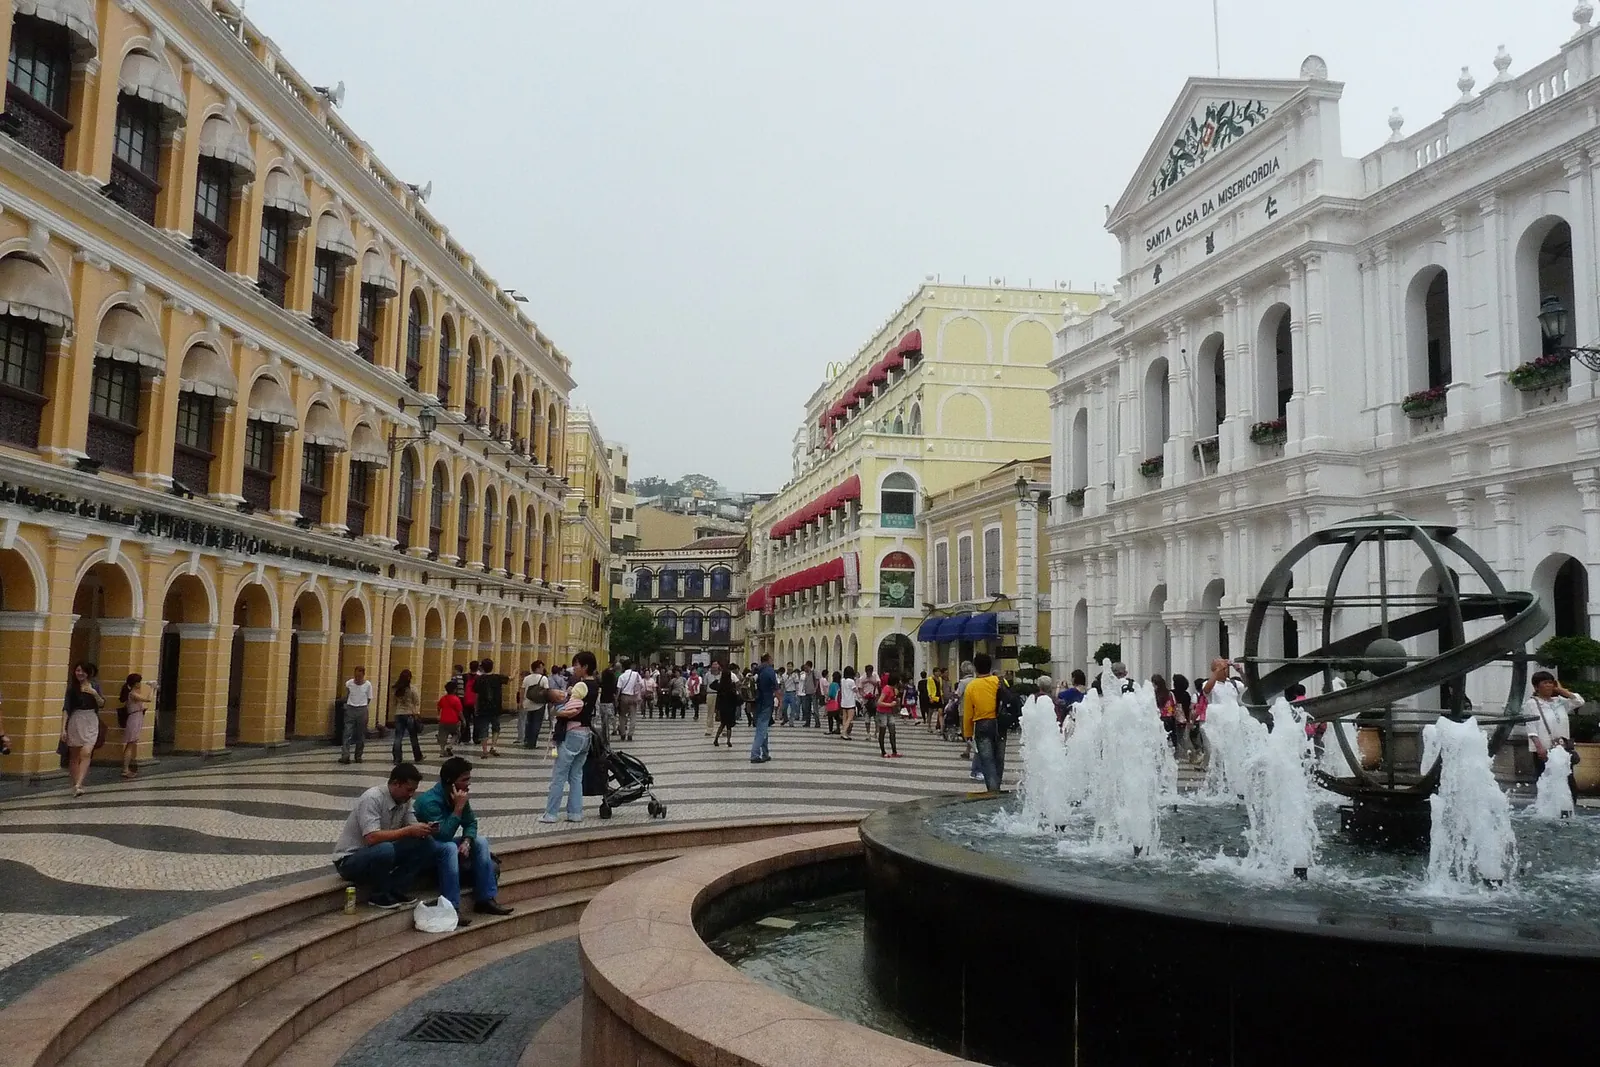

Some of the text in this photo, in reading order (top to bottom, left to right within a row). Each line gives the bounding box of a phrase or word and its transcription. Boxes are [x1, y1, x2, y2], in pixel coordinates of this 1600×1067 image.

[1146, 156, 1280, 252] SANTA CASA DA MISERICORDIA
